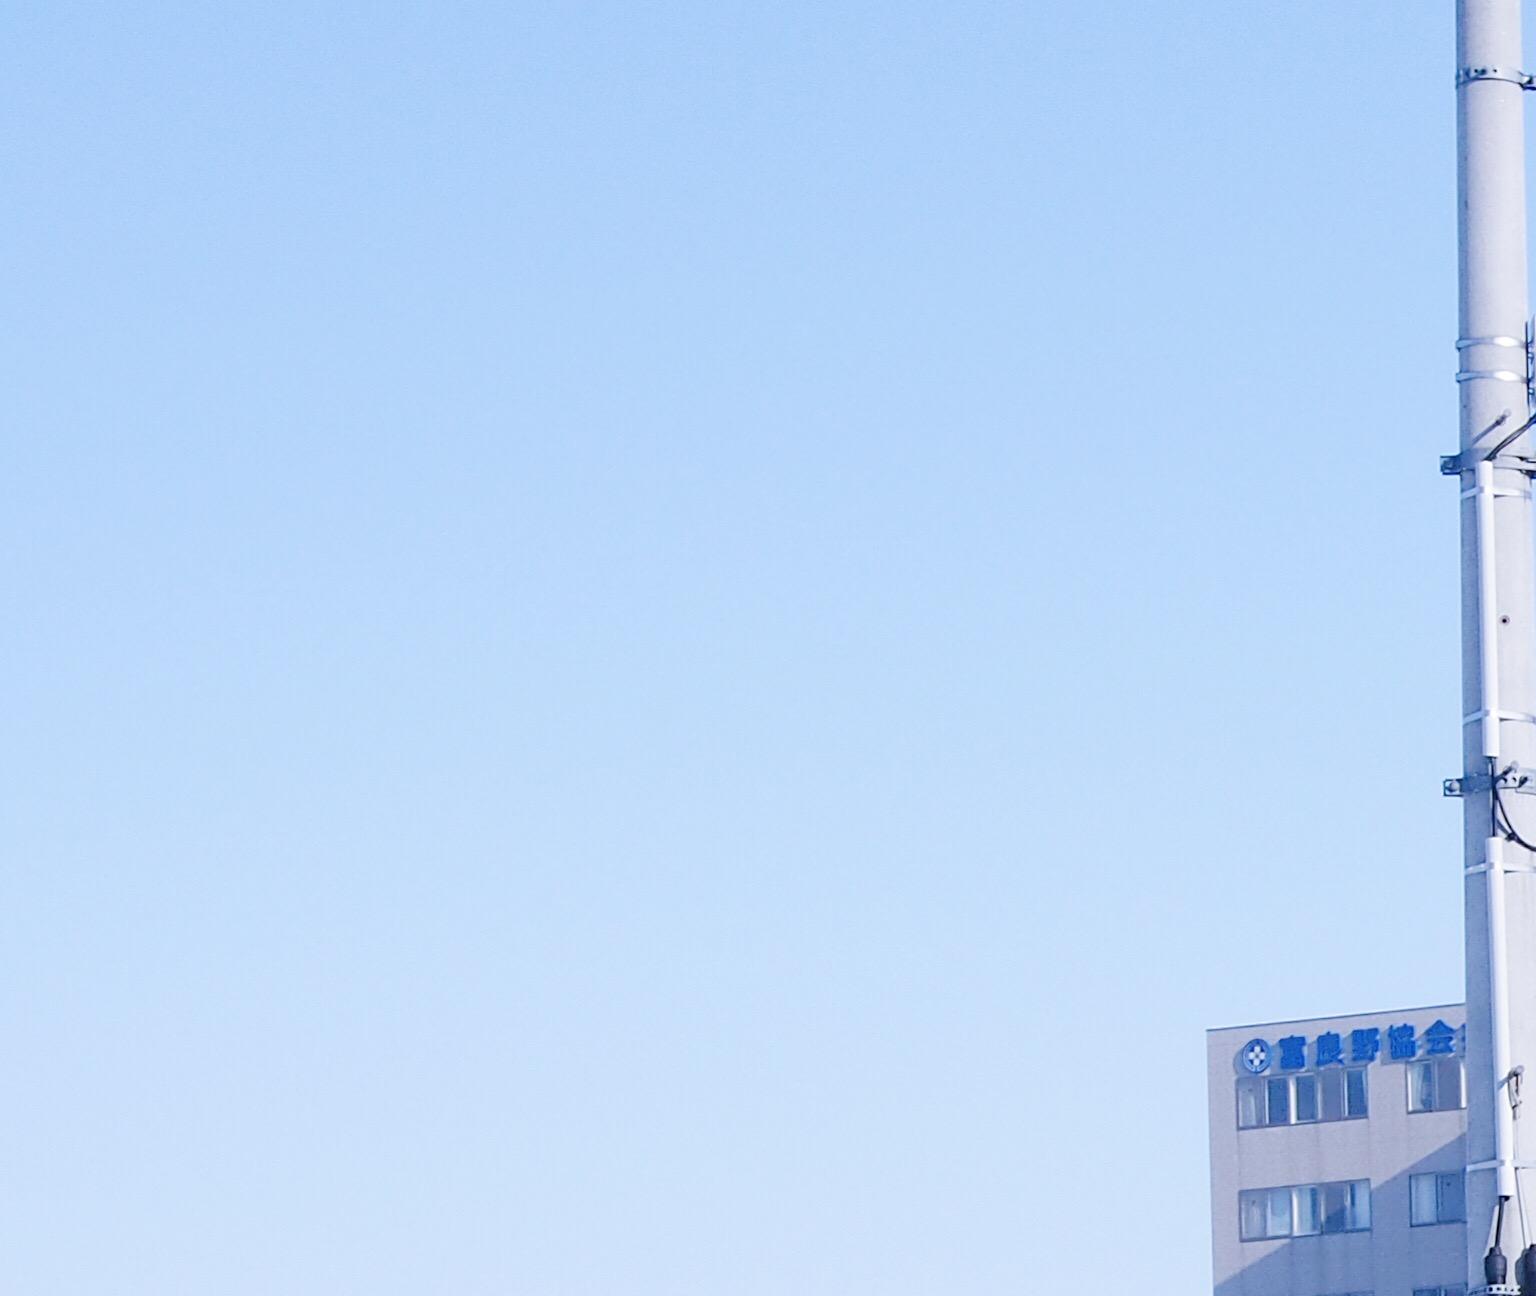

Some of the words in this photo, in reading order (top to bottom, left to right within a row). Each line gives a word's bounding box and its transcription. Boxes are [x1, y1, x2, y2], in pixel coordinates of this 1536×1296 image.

[1279, 1019, 1466, 1071] 富良野協会
